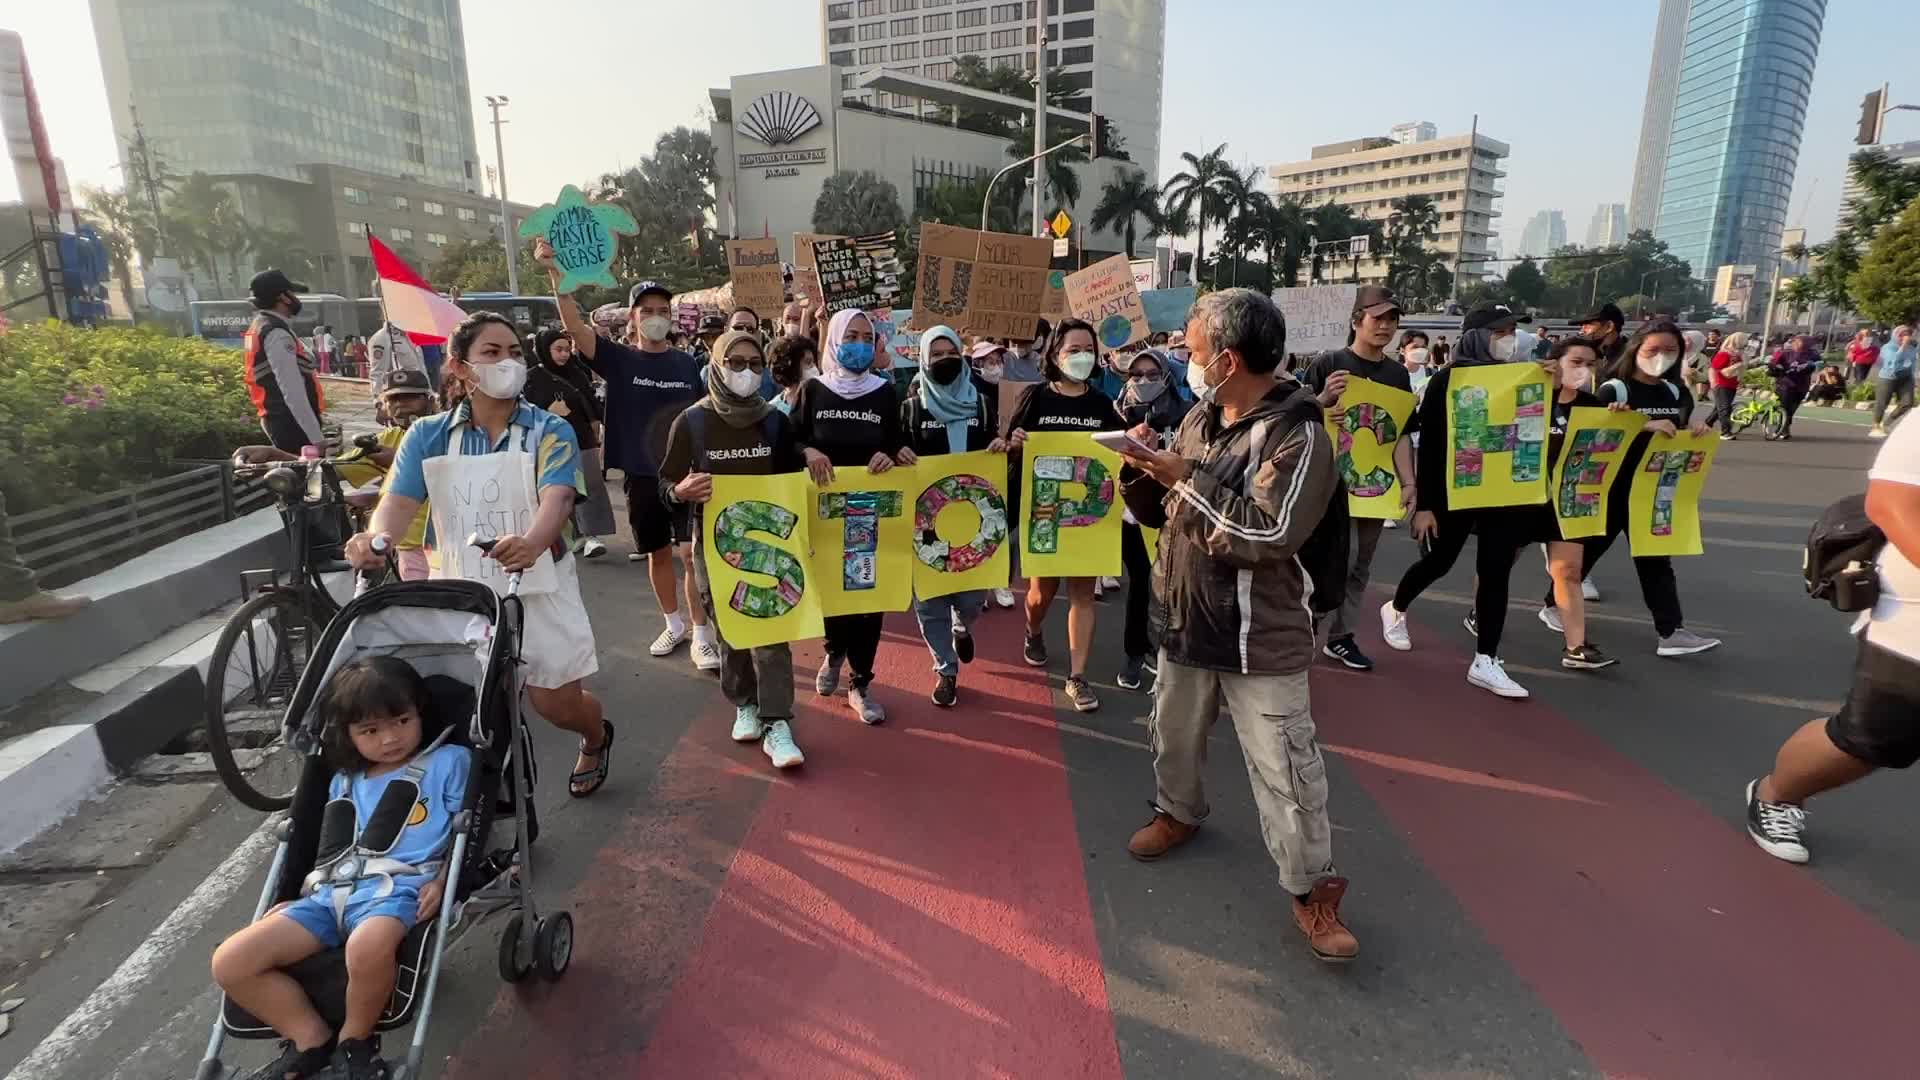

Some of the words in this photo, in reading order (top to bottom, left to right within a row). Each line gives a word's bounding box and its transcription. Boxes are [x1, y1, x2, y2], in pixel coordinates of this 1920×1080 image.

[551, 211, 567, 228] NO
[549, 220, 605, 249] PLASTIC
[816, 240, 838, 253] WE
[556, 243, 606, 271] PLEASE
[817, 249, 854, 262] NEVER
[821, 260, 853, 273] ASKED
[1081, 291, 1137, 323] PLASTIC
[453, 478, 501, 505] NO
[448, 508, 531, 538] PLASTIC
[863, 557, 872, 581] Molto
